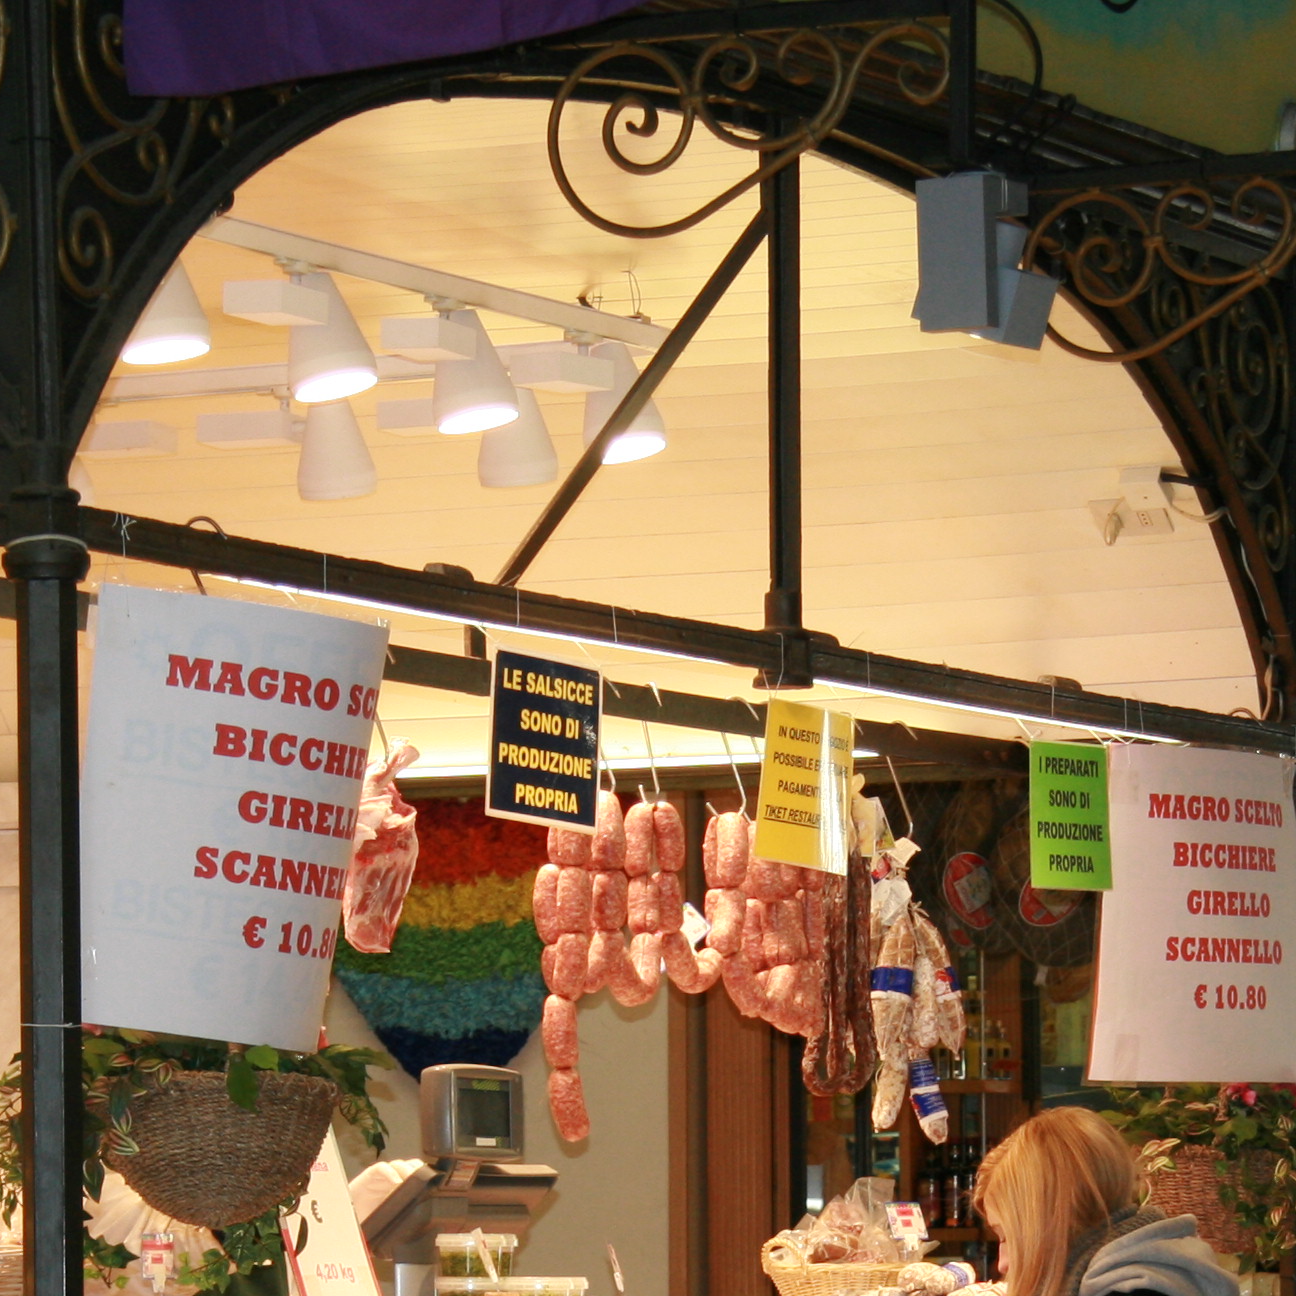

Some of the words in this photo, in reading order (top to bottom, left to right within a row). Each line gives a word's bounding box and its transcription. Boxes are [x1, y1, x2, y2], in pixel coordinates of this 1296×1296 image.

[165, 653, 341, 712] MAGRO
[502, 667, 523, 691] LE
[526, 671, 594, 706] SALSICCE
[520, 708, 562, 736] SONO
[565, 717, 580, 740] DI
[778, 725, 788, 738] IN
[789, 727, 821, 745] QUESTO
[498, 742, 592, 779] PRODUZIONE
[773, 751, 814, 771] POSSIBILE
[1039, 755, 1043, 773] I
[1045, 756, 1099, 778] PREPARATI
[515, 782, 579, 814] PROPRIA
[764, 804, 788, 820] TIKET
[1048, 789, 1078, 809] SONO
[1079, 791, 1091, 809] DI
[1148, 793, 1230, 822] MAGRO
[1235, 799, 1283, 828] SCELTO
[1037, 821, 1103, 842] PRODUZIONE
[1049, 854, 1095, 873] PROPRIA
[1173, 841, 1277, 873] BICCHIERE
[1186, 889, 1271, 918] GIRELLO
[242, 915, 267, 949] €
[1165, 936, 1283, 965] SCANNELLO
[1194, 984, 1207, 1009] €
[1215, 984, 1267, 1011] 10.80
[310, 1199, 323, 1224] €
[316, 1263, 340, 1283] 4,20
[340, 1263, 356, 1283] kg
